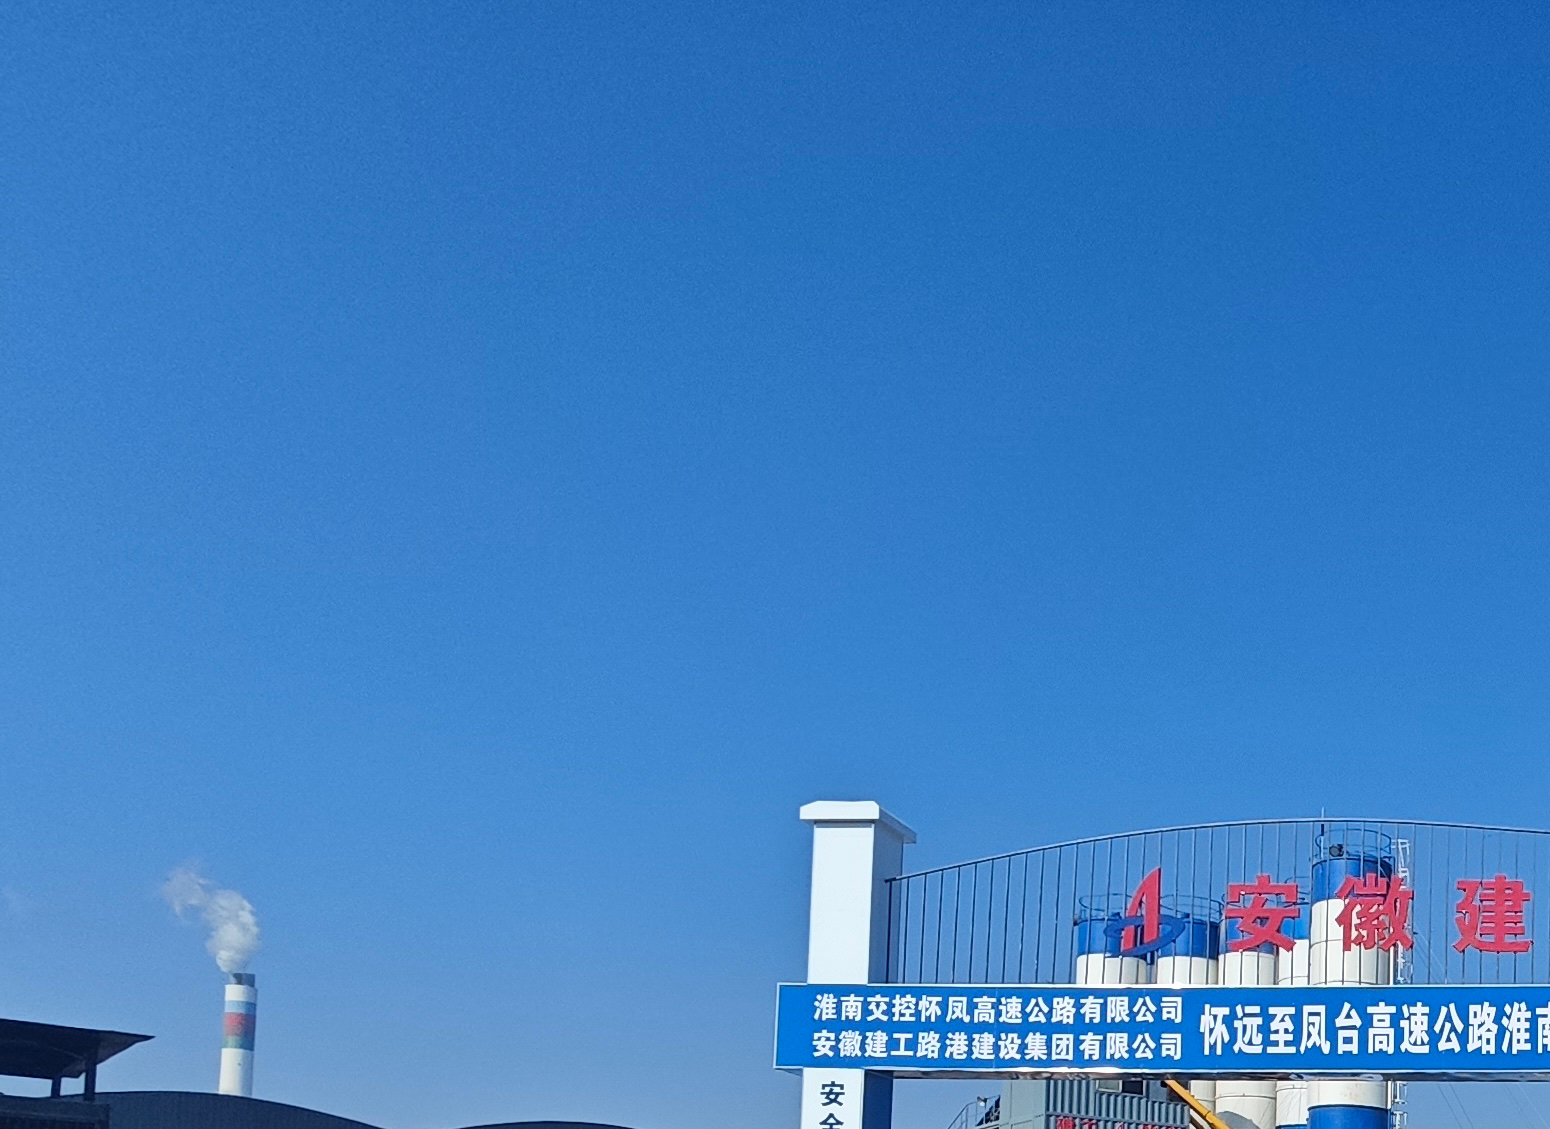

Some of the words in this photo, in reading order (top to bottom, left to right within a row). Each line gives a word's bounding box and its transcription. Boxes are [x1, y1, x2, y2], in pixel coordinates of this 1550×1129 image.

[813, 993, 1184, 1025] 淮南交控怀凤高速公路有限公司
[812, 1029, 1184, 1062] 安徽建工路港建设集团有限公司
